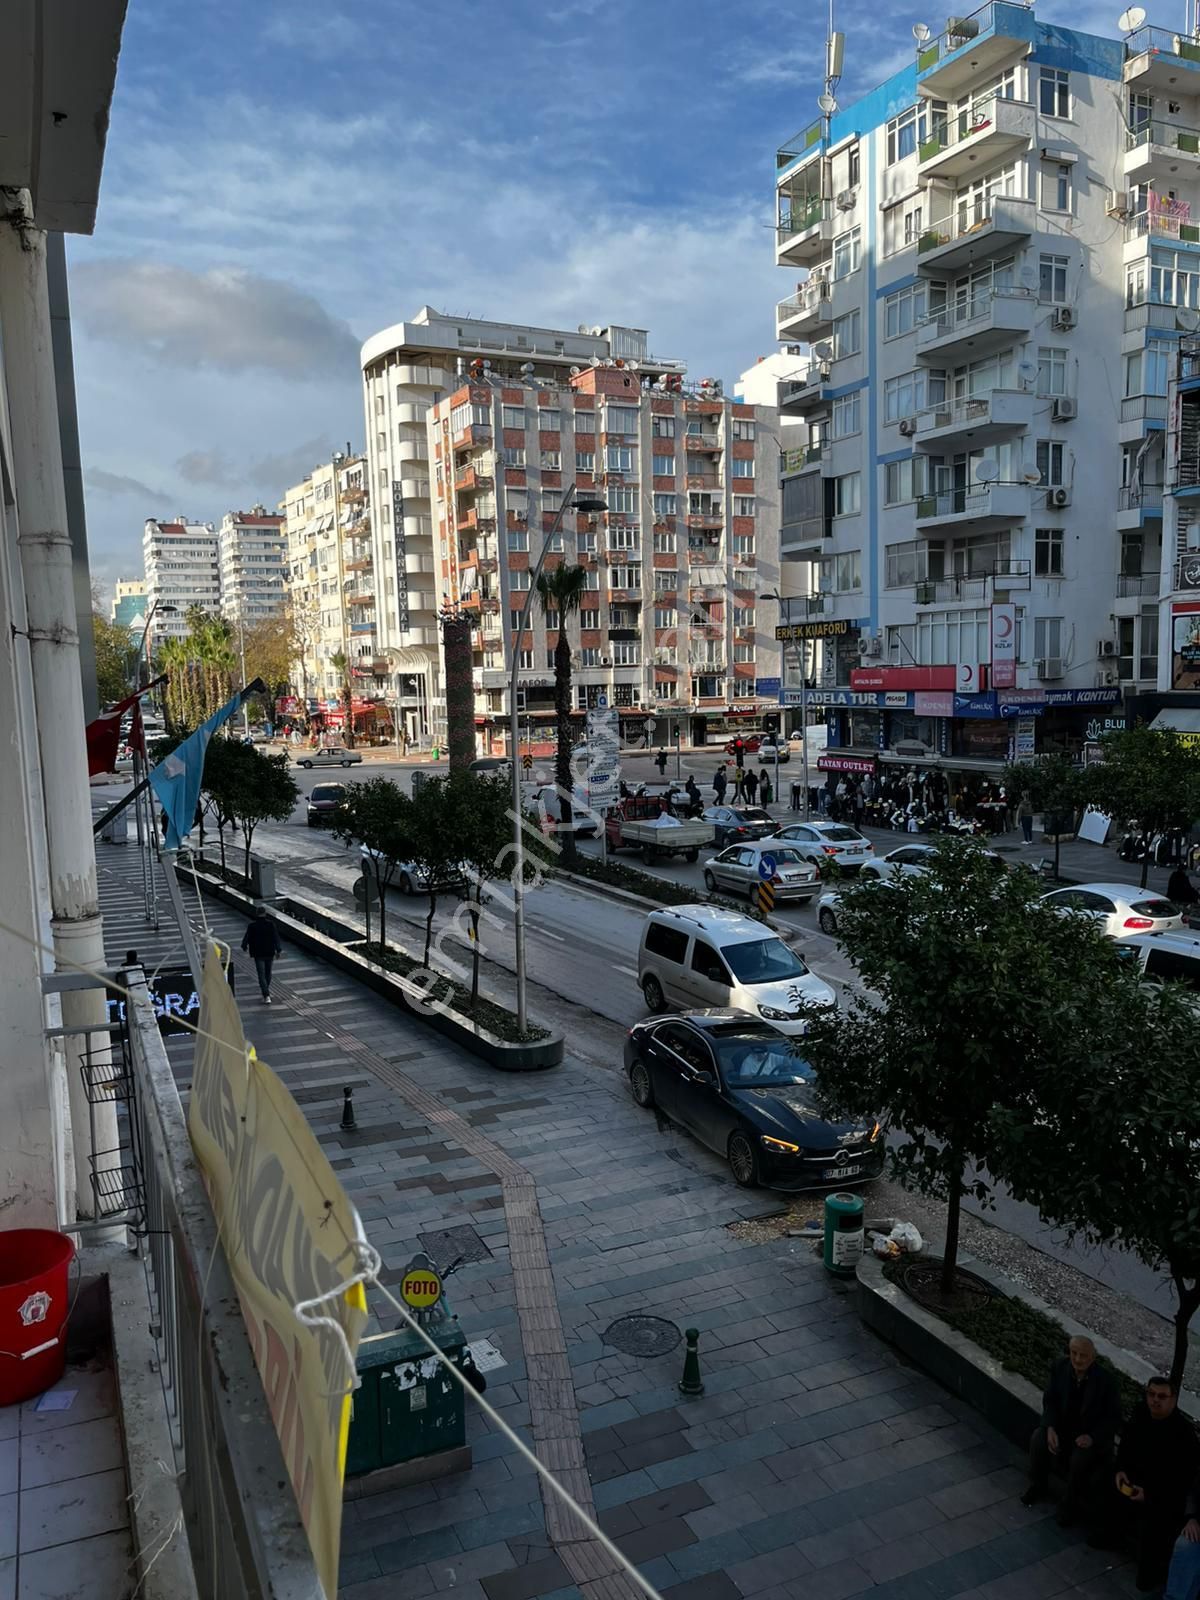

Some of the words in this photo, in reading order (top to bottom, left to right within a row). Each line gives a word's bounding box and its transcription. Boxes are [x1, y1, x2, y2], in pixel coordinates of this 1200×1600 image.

[393, 483, 403, 535] HOTEL
[776, 627, 804, 639] ERKEK
[807, 692, 847, 705] ADELA
[851, 692, 878, 705] TUR
[1076, 690, 1119, 702] KONTUR
[819, 759, 841, 769] BAYAN
[843, 761, 875, 773] OUTLET
[404, 1280, 438, 1296] FOTO
